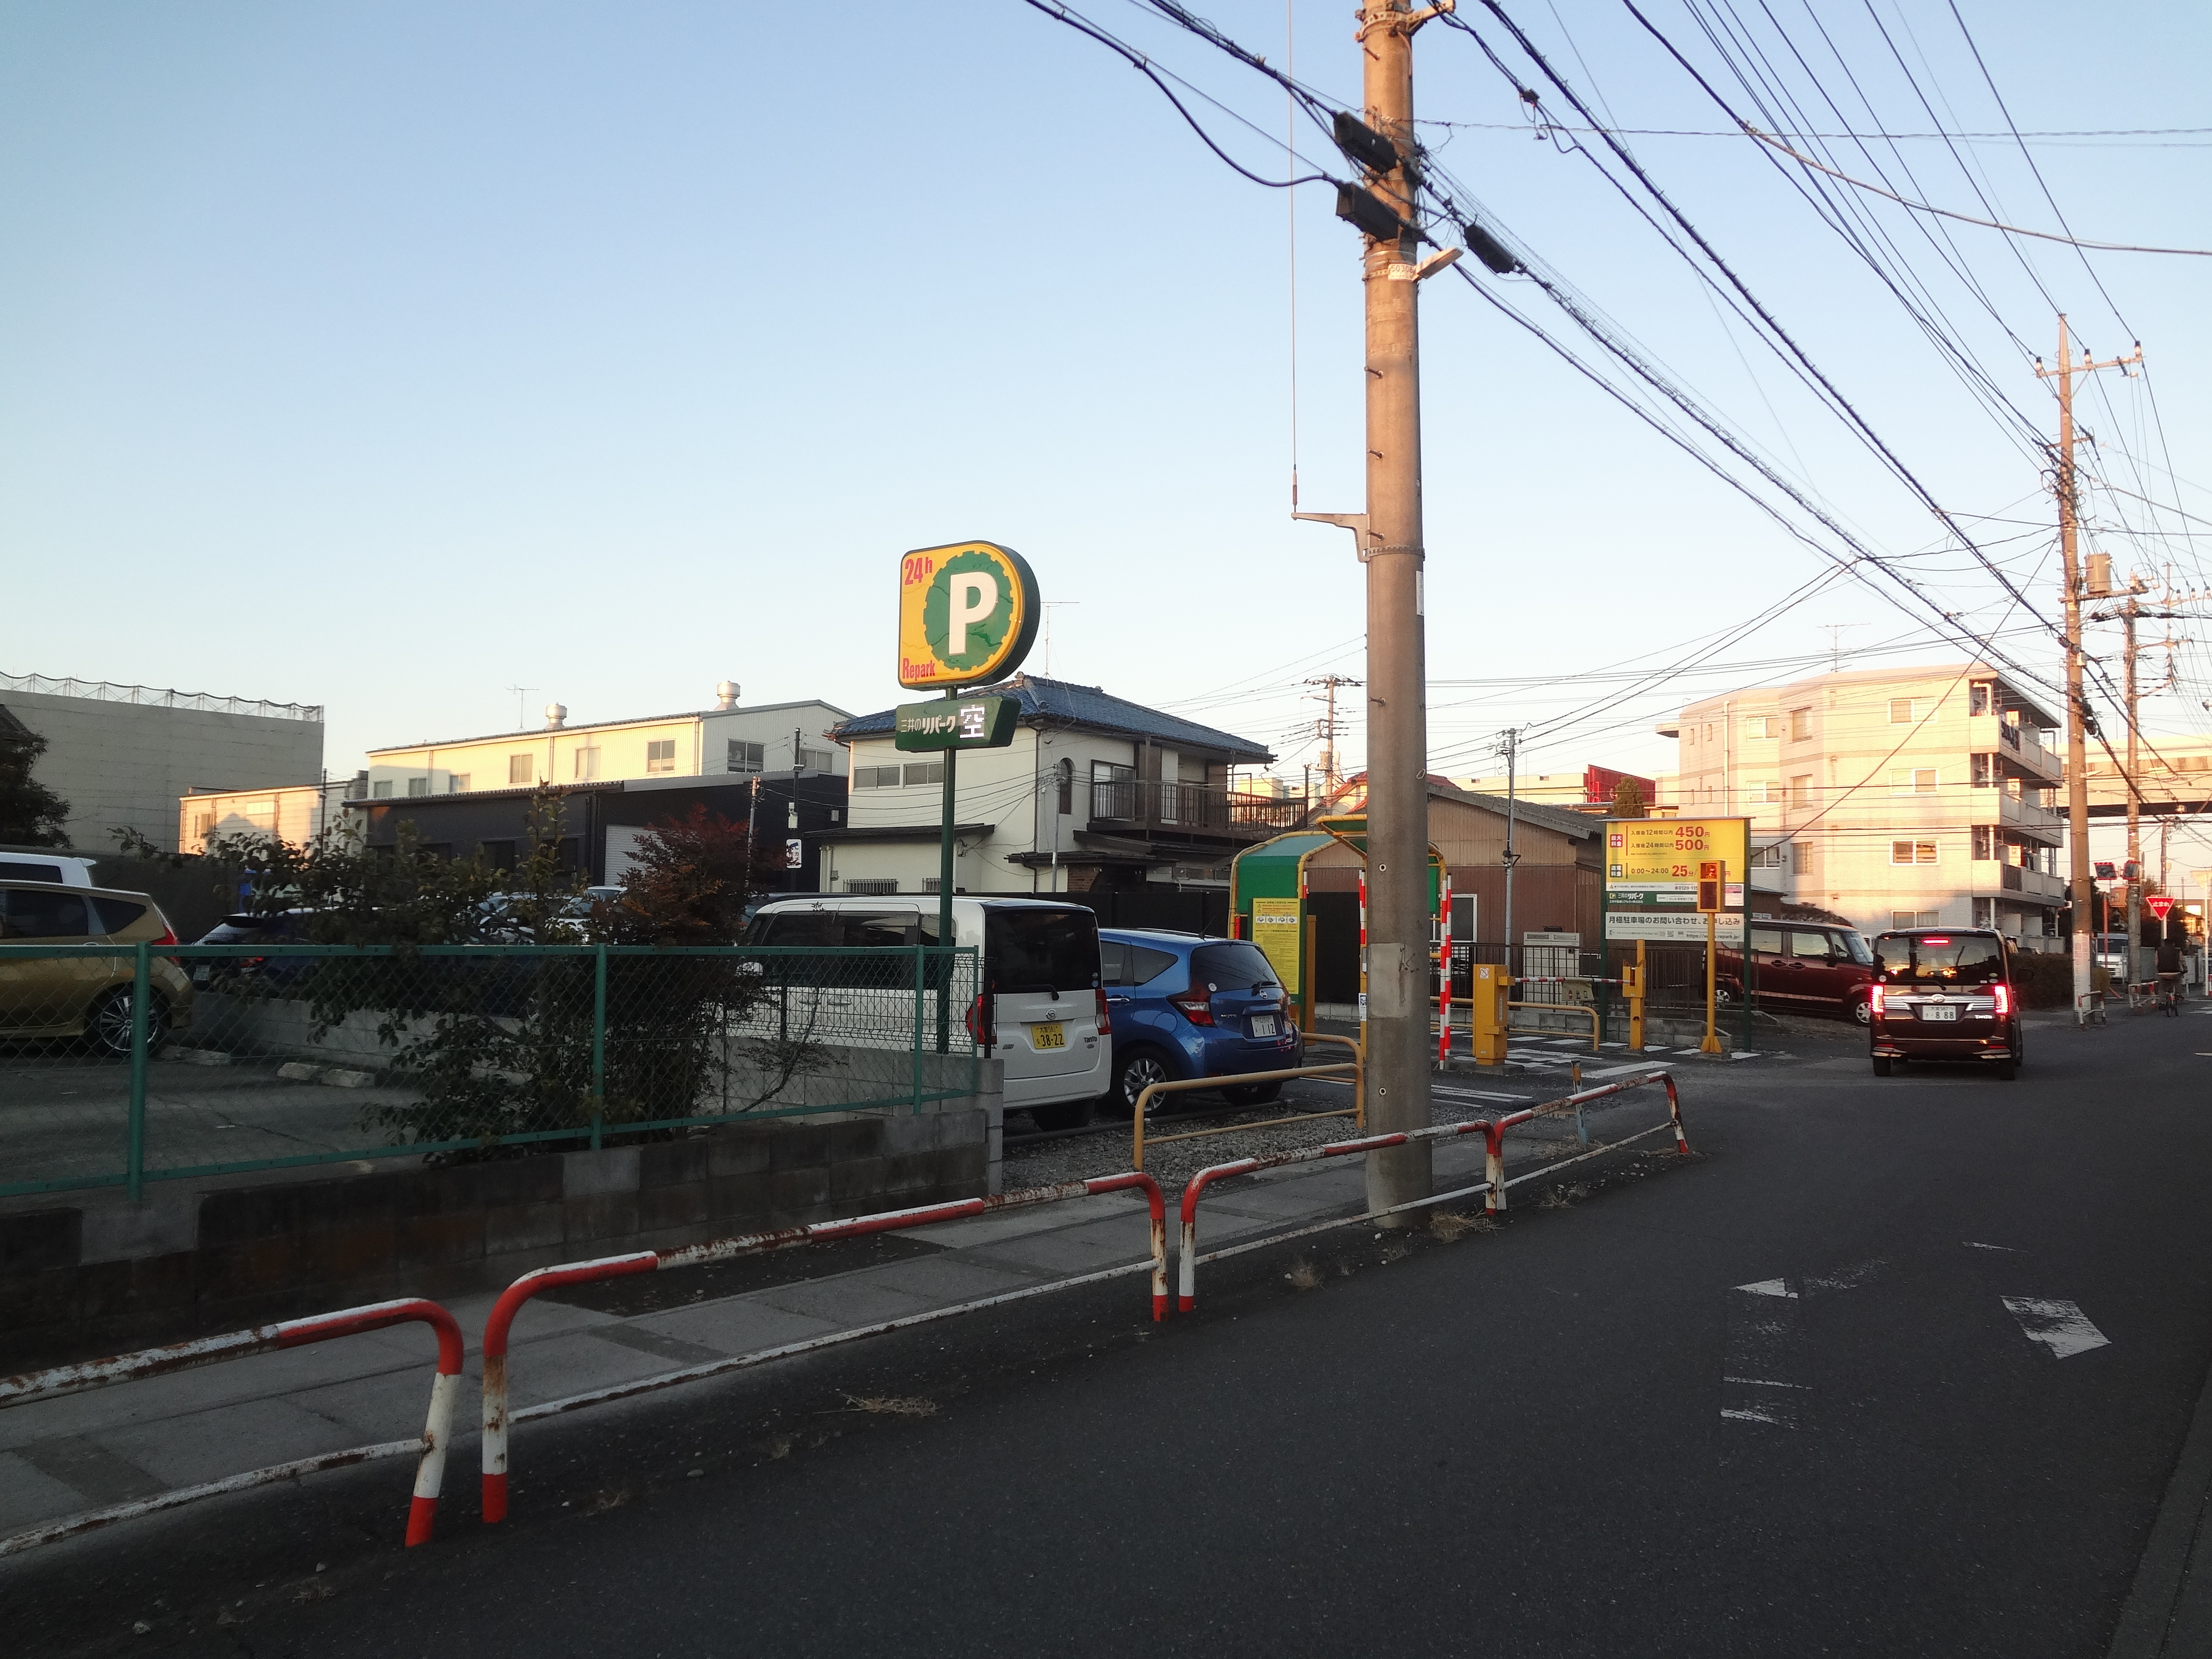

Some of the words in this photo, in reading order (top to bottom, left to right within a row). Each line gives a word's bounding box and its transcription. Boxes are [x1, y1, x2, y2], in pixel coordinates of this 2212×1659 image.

[904, 557, 933, 586] 24h
[949, 571, 998, 656] P
[902, 658, 936, 681] Repark
[900, 715, 956, 735] 三井のリパーク
[960, 704, 985, 739] 空
[1675, 826, 1710, 838] 450円
[1675, 839, 1709, 851] 500円
